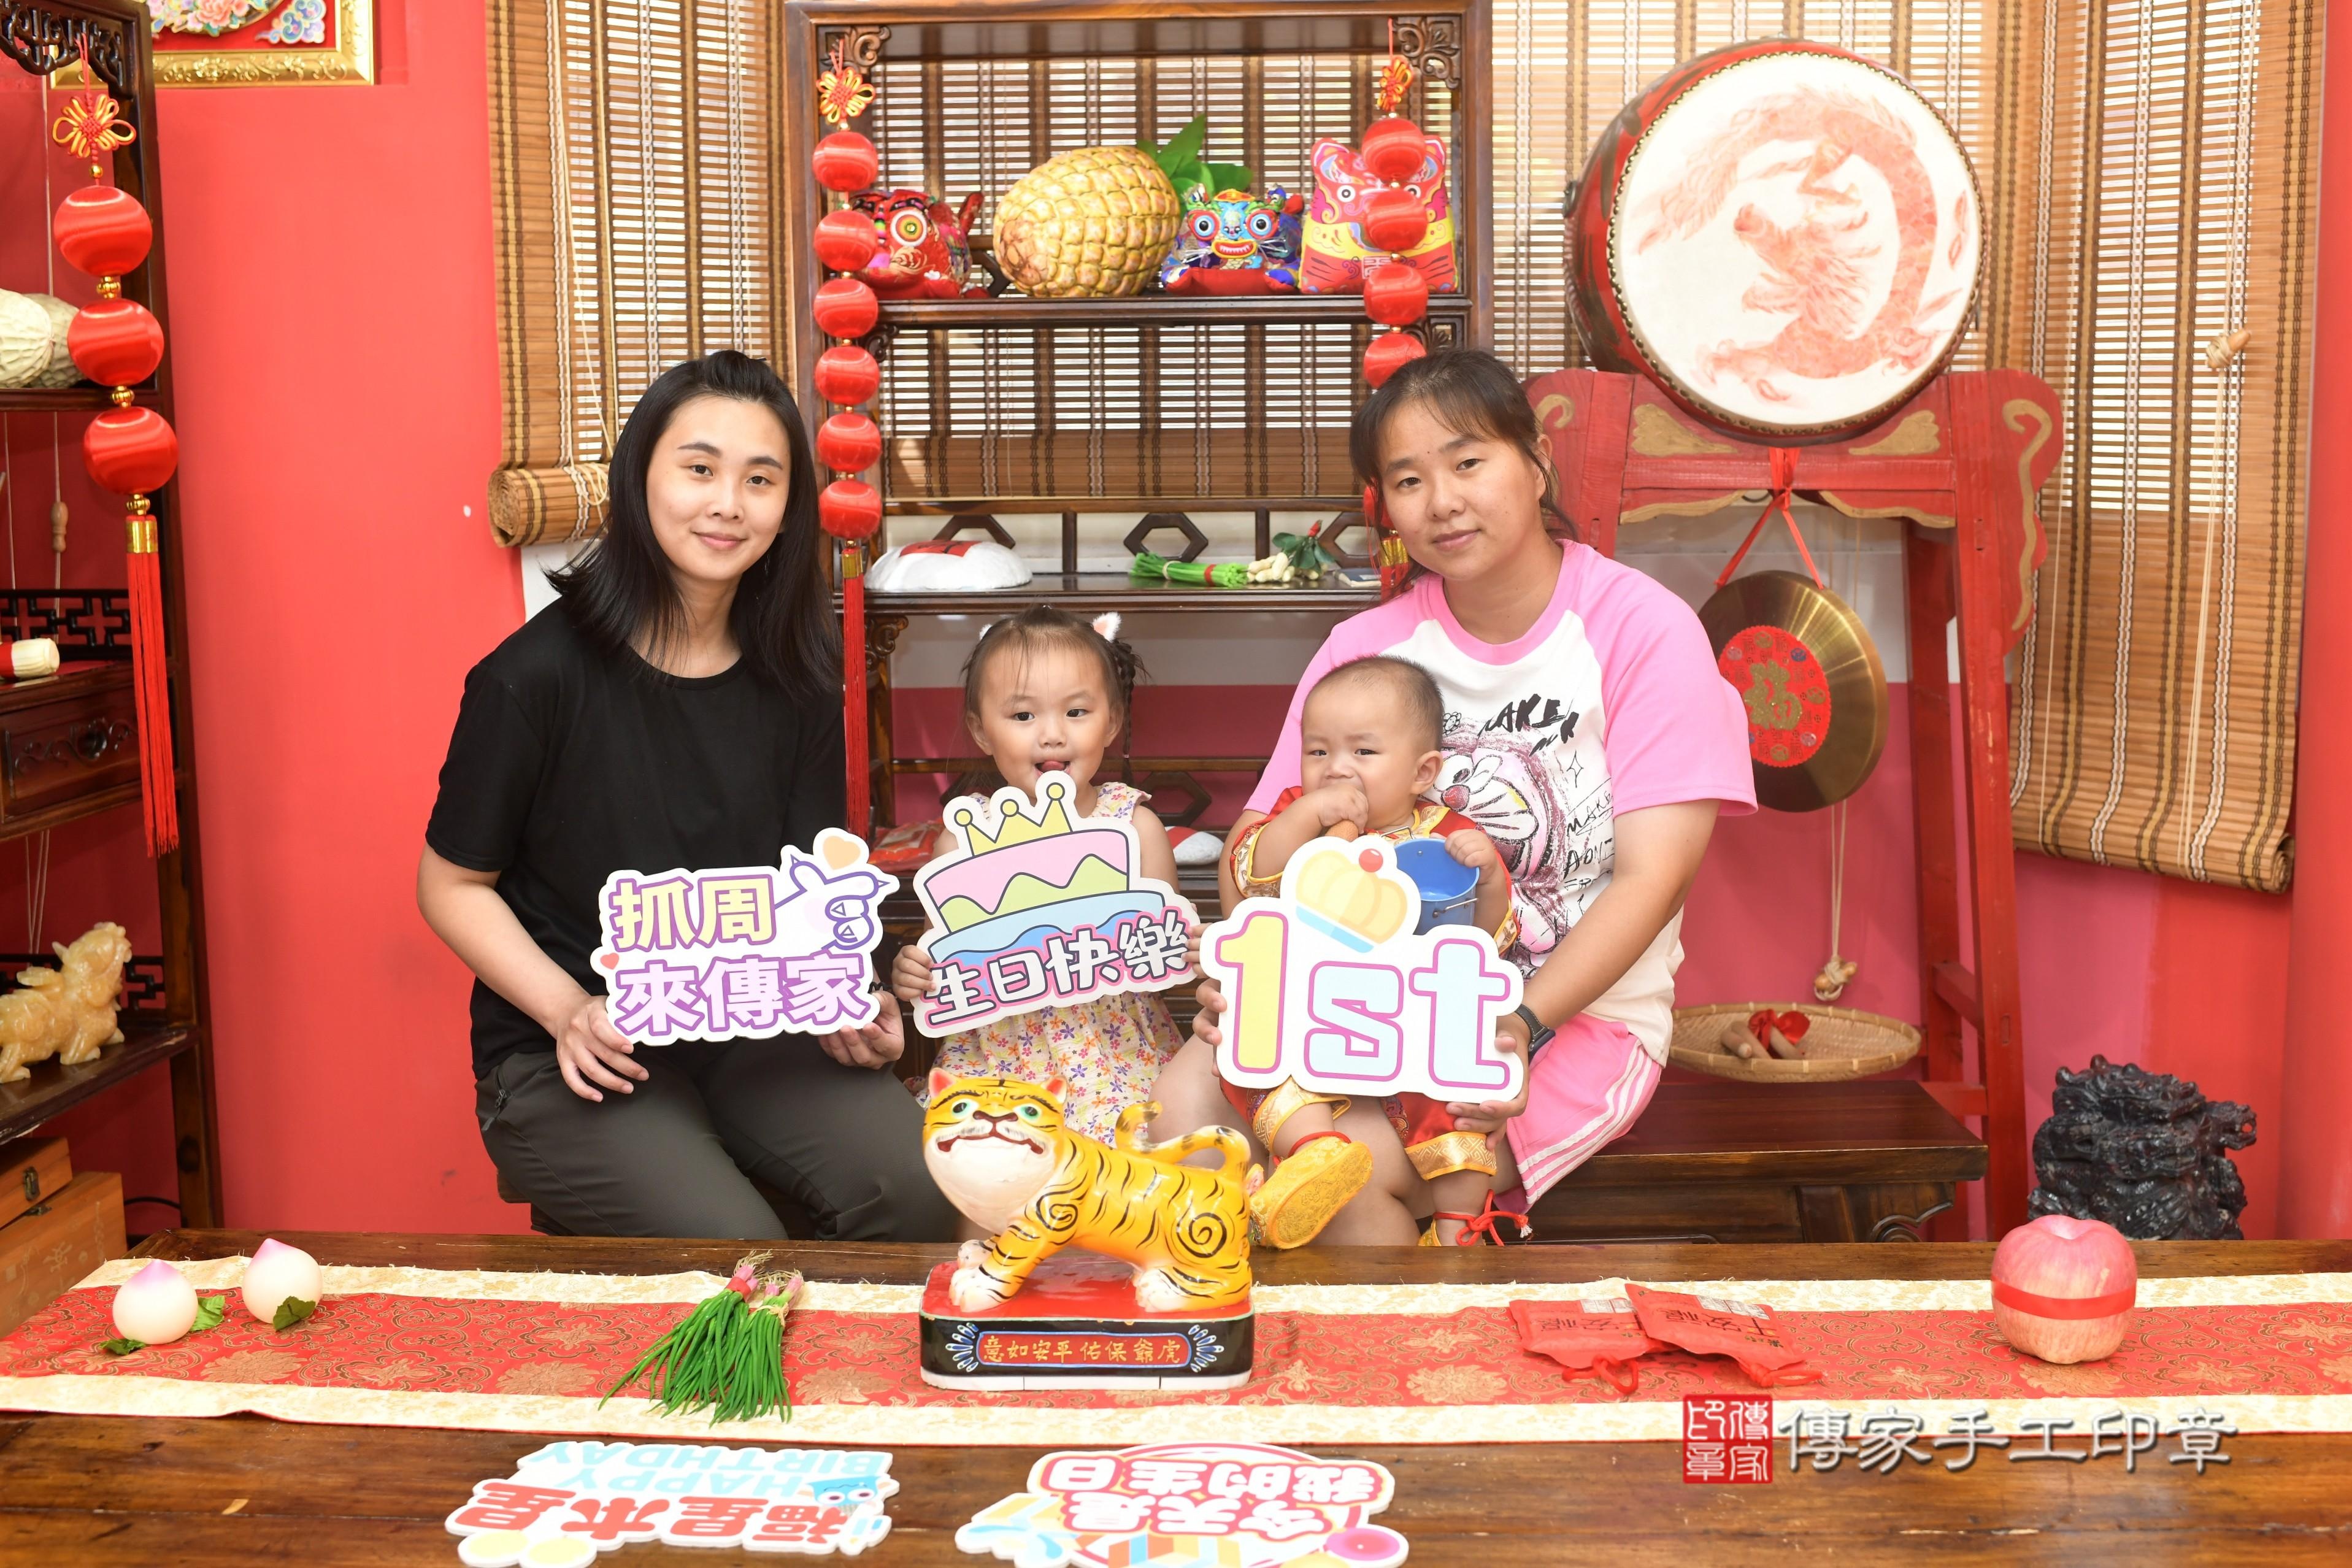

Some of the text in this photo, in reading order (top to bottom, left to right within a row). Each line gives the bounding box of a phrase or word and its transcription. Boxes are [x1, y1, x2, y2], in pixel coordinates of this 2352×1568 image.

[609, 874, 777, 953] 抓周
[613, 948, 872, 1037] 來傳家
[923, 908, 1191, 1026] 生日快樂
[1215, 910, 1511, 1090] 1st
[529, 1442, 886, 1475] BIRTHDAY
[551, 1467, 804, 1498] HAPPY
[1047, 1458, 1375, 1503] 我的生日
[455, 1482, 848, 1544] 福星本星
[1069, 1492, 1326, 1540] 今天是
